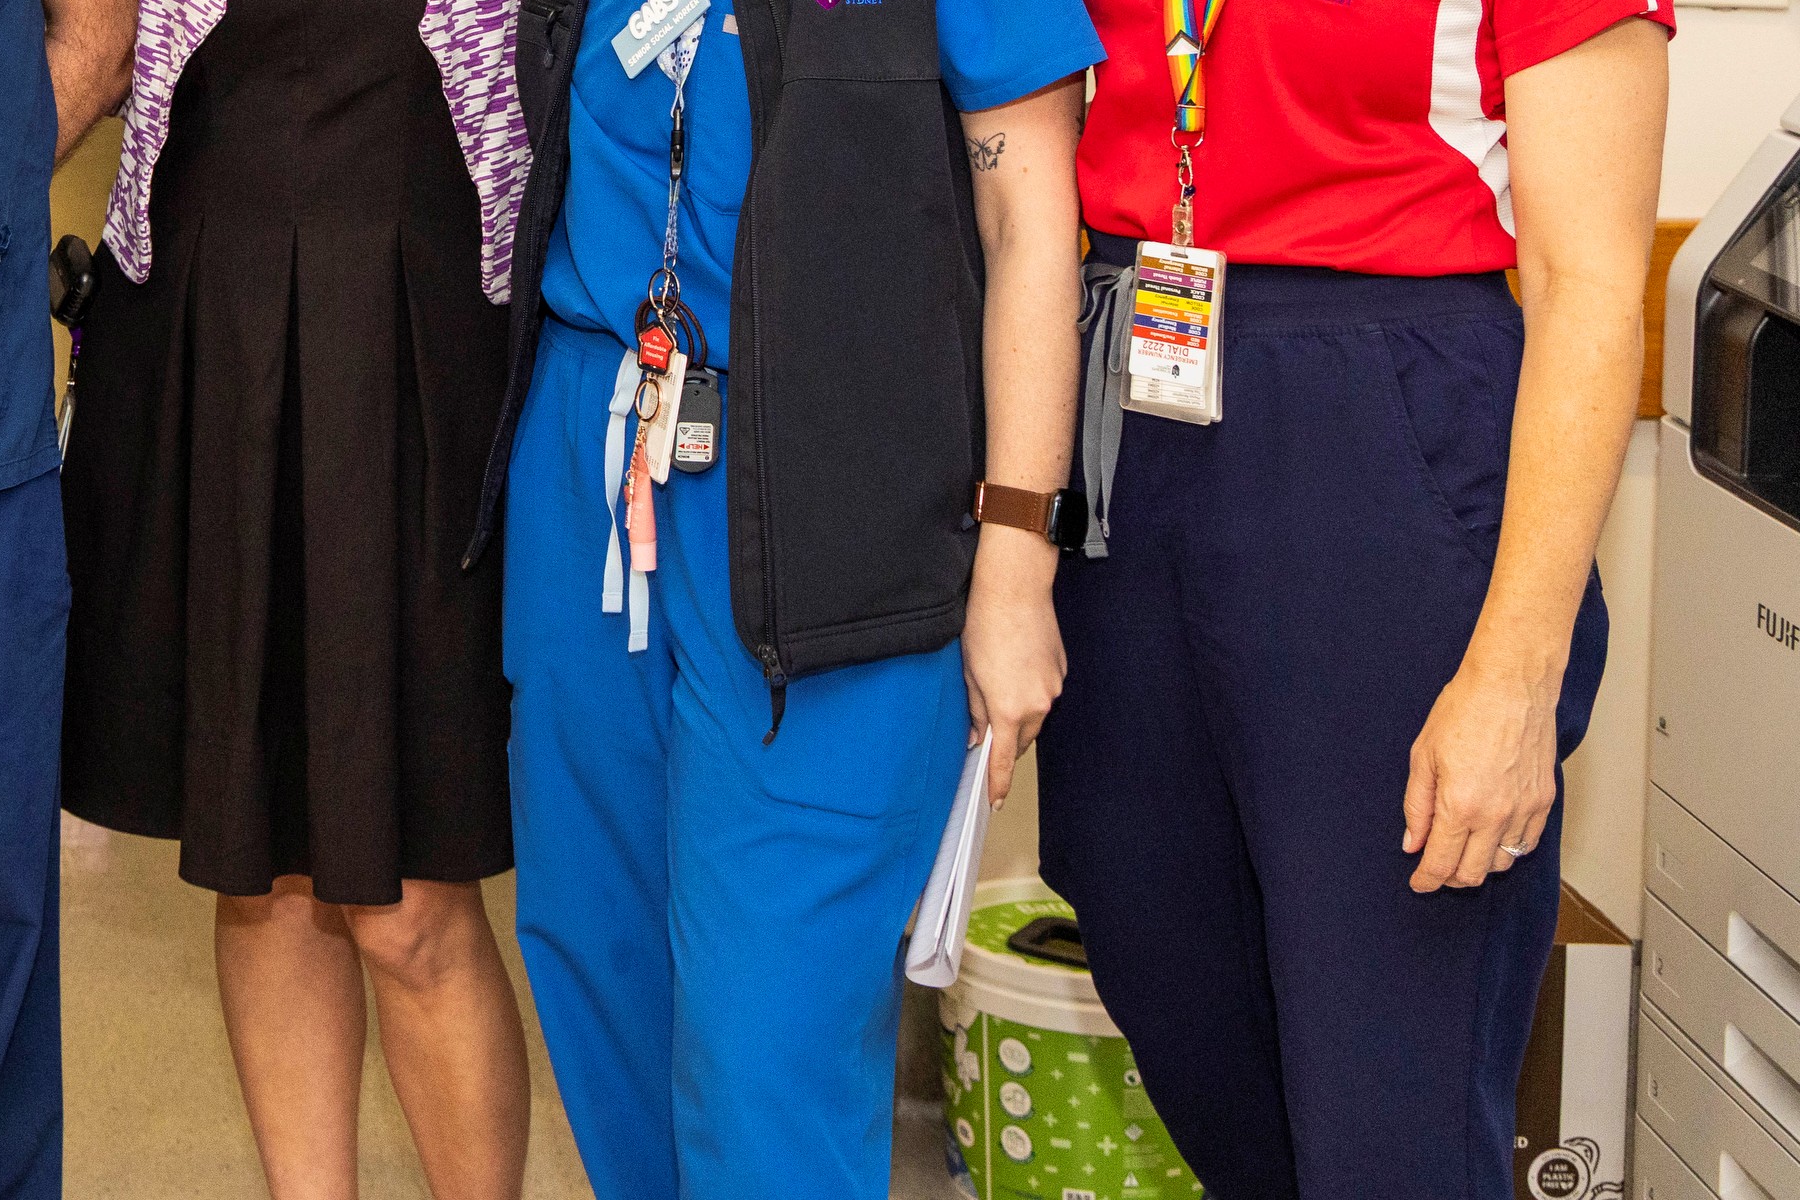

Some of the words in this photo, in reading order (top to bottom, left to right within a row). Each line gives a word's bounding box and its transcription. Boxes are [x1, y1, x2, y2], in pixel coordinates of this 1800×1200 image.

[627, 42, 652, 67] SENIOR
[650, 22, 674, 46] SOCIAL
[644, 342, 667, 352] Affordable
[1143, 340, 1165, 352] 2222
[1167, 344, 1189, 356] DIAL
[645, 351, 664, 361] Housing
[1137, 349, 1163, 360] NUMBER
[1163, 353, 1198, 365] EMERGENCY
[1758, 603, 1800, 650] FUJIF
